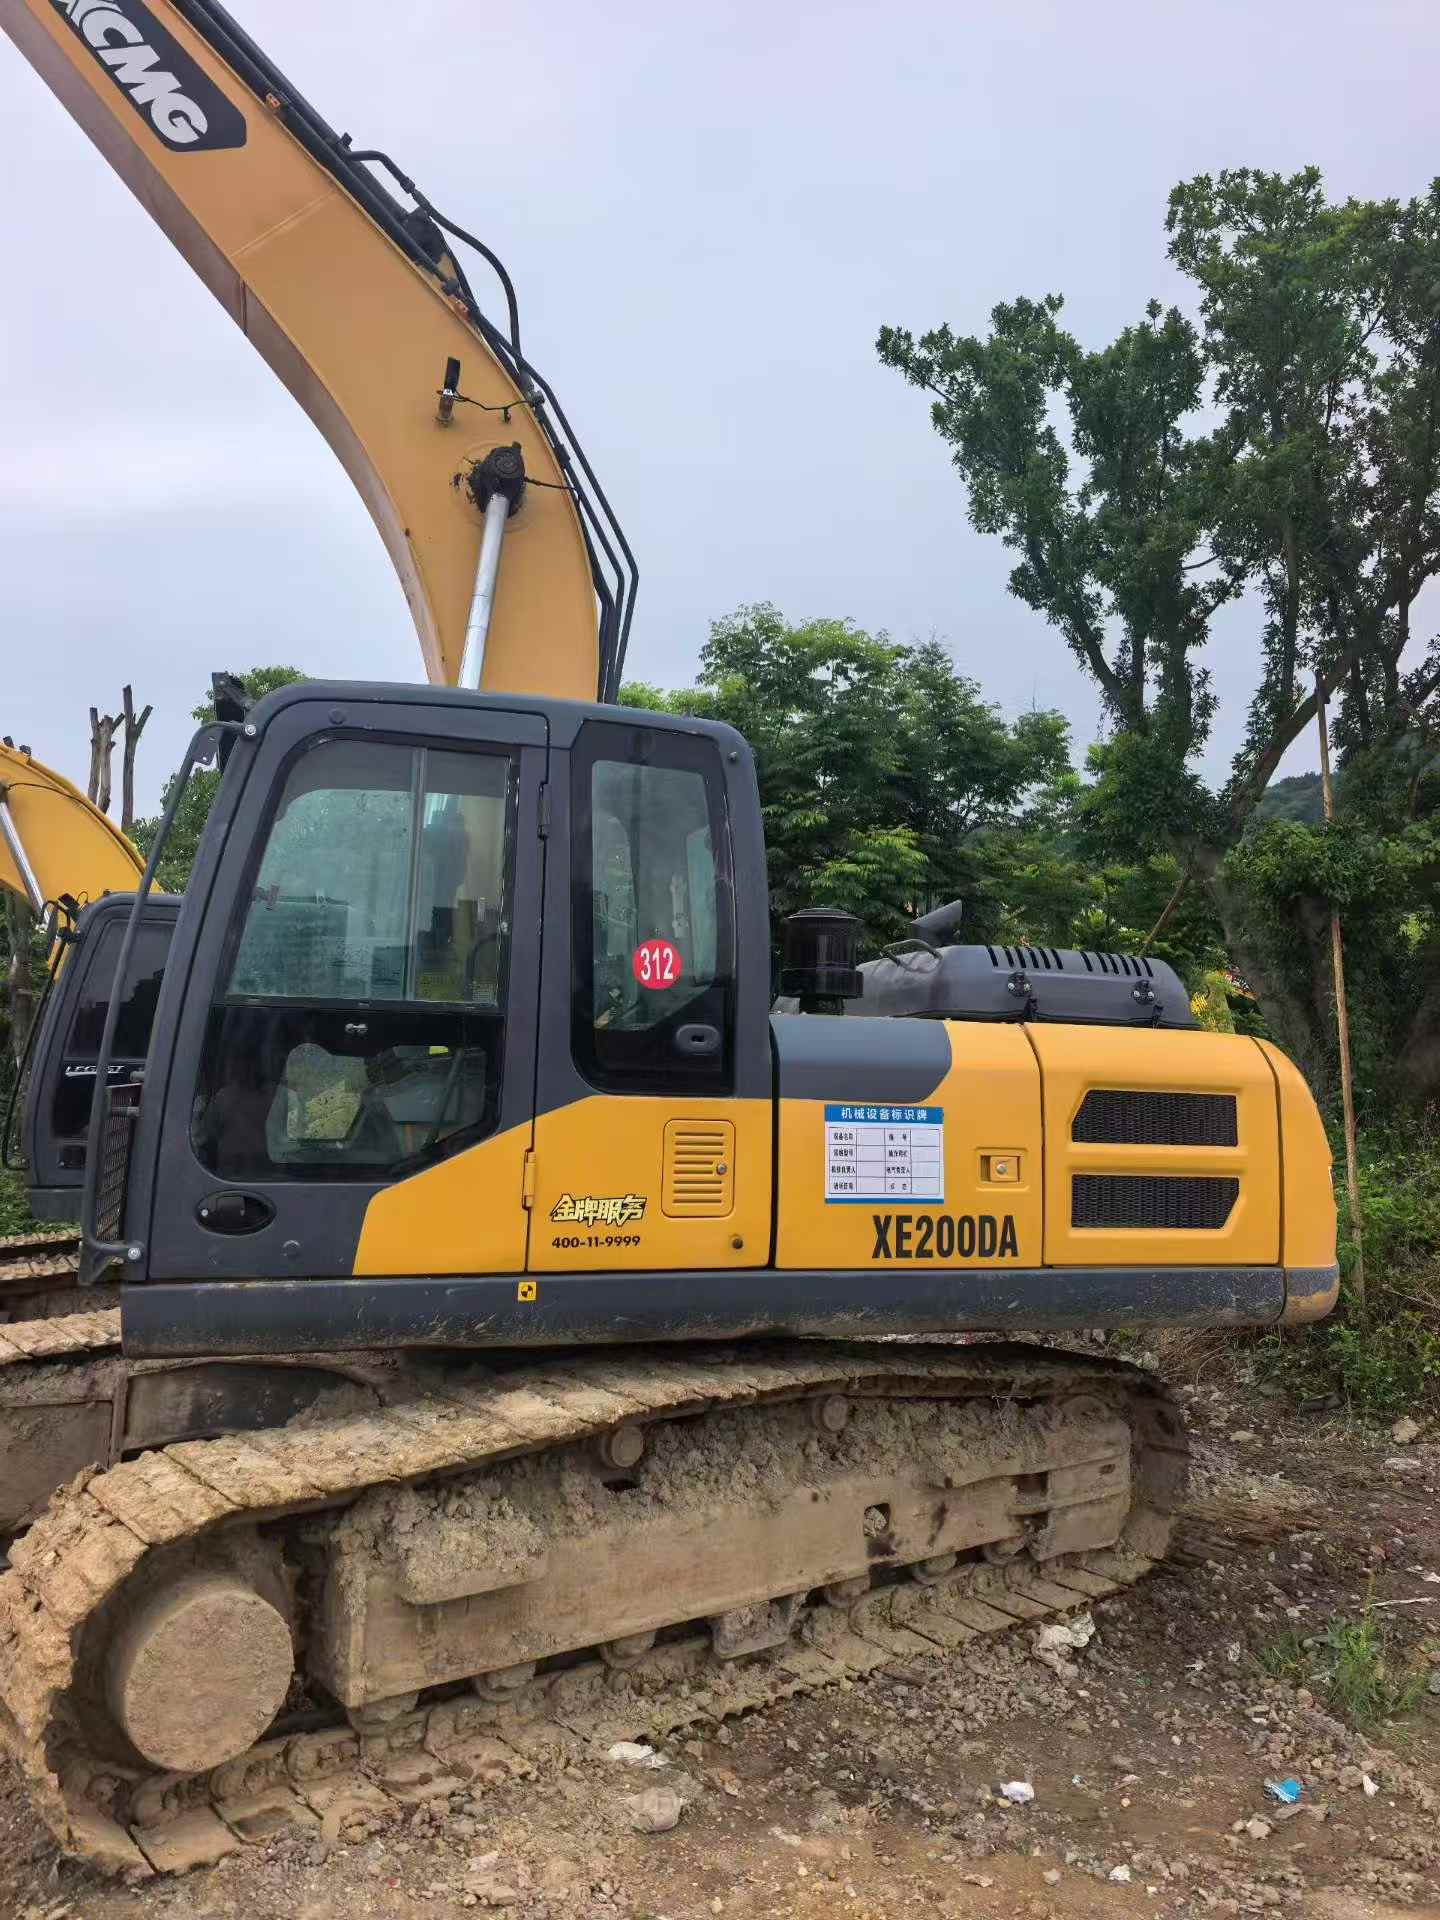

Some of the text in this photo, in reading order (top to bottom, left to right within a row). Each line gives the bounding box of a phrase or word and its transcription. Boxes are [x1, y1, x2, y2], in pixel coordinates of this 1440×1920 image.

[641, 947, 673, 980] 312
[841, 1107, 927, 1120] 机械设备标识牌
[551, 1193, 647, 1227] 金牌服务
[552, 1236, 640, 1248] 400-11-9999
[872, 1215, 1018, 1258] XE200DA
